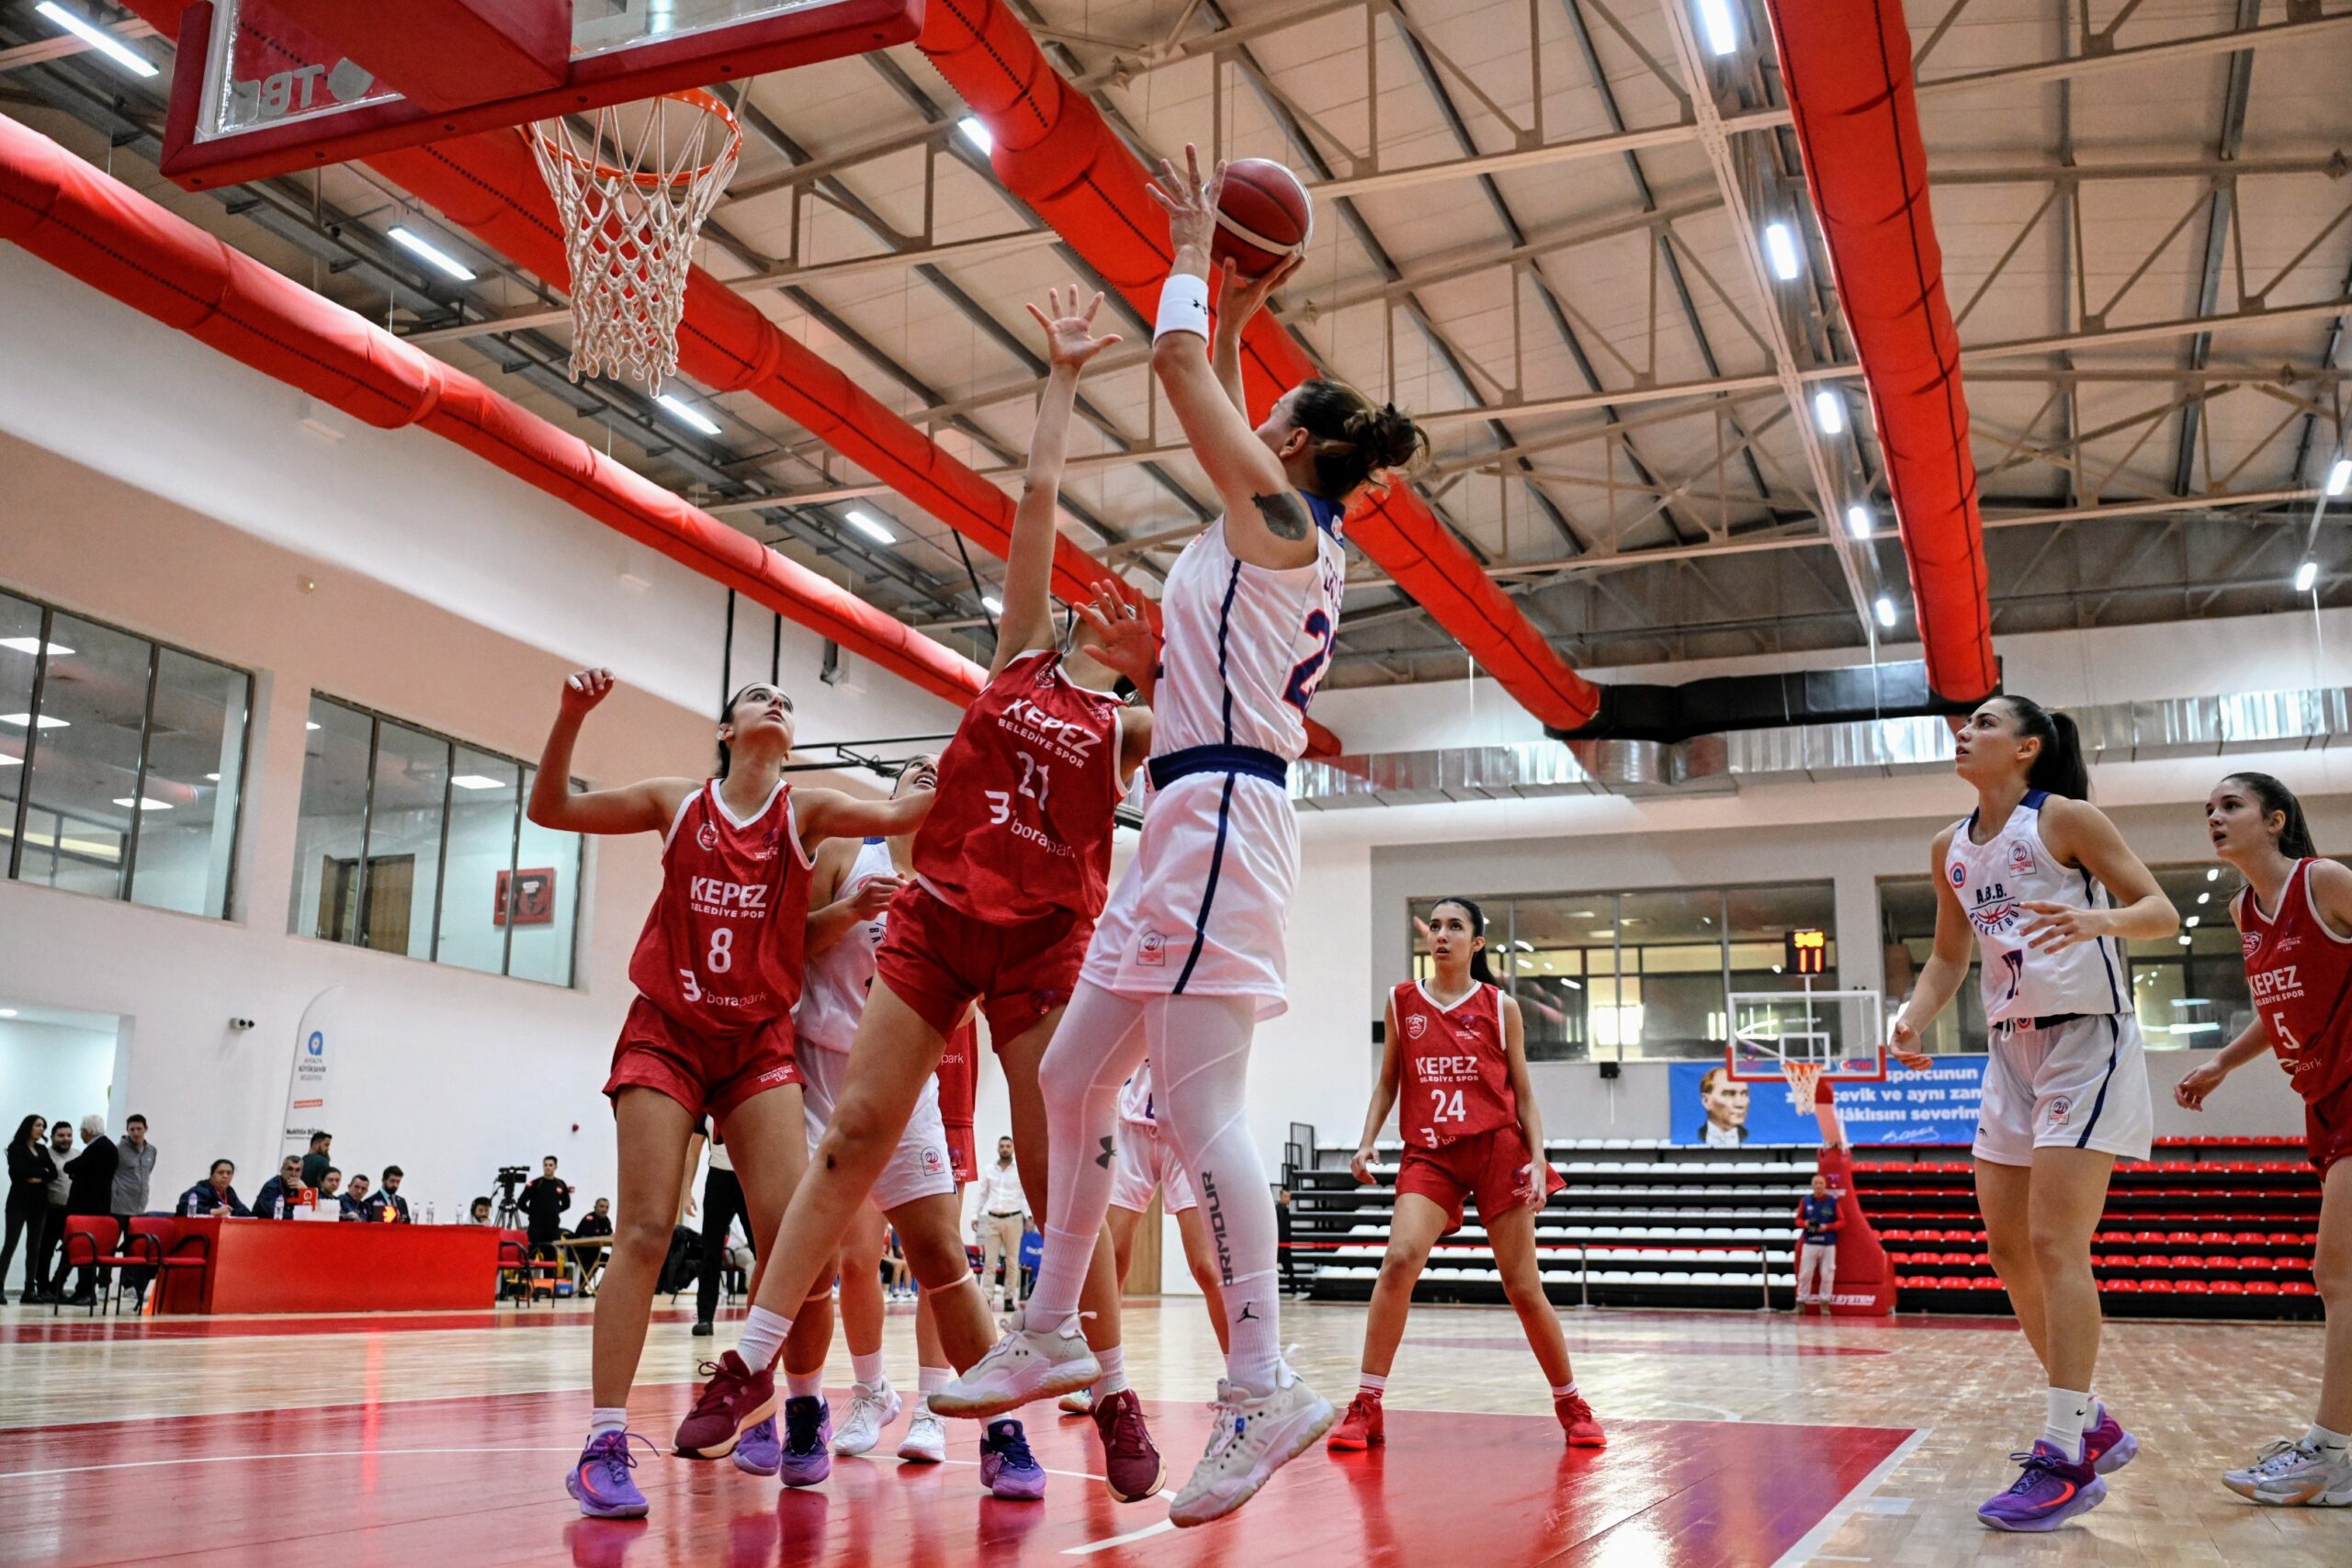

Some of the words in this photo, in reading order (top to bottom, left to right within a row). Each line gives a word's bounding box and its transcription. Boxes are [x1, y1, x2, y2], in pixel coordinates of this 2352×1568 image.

[998, 717, 1055, 750] BELEDİYE
[1054, 747, 1085, 769] SPOR
[1001, 698, 1102, 758] KEPEZ
[1016, 750, 1049, 812] 21
[690, 875, 768, 908] KEPEZ
[707, 927, 733, 974] 8
[1800, 948, 1822, 973] 11
[2247, 964, 2302, 998] KEPEZ
[2281, 989, 2305, 1000] SPOR
[2272, 1011, 2301, 1050] 5
[1416, 1055, 1478, 1076] KEPEZ
[1430, 1089, 1466, 1123] 24
[1881, 1090, 1903, 1101] ve
[1906, 1089, 1946, 1103] aynı
